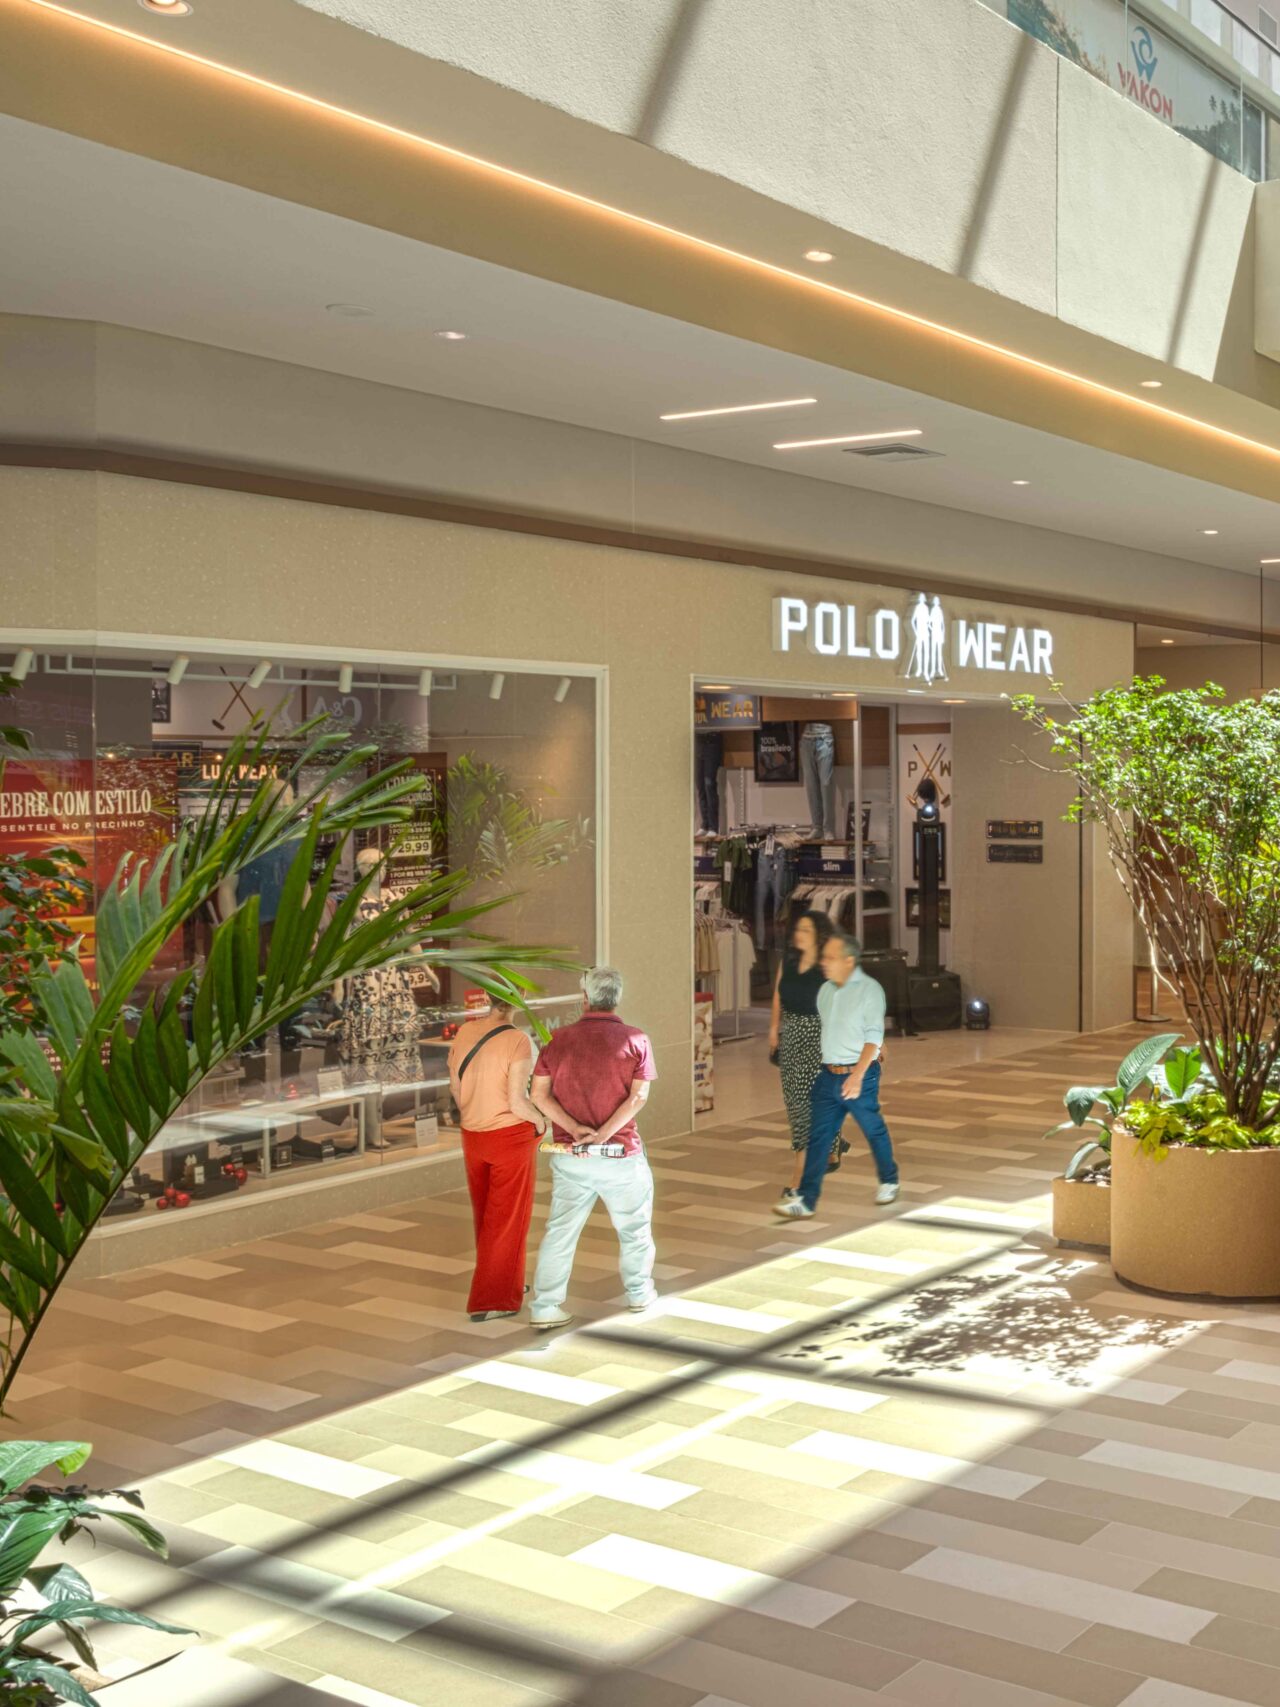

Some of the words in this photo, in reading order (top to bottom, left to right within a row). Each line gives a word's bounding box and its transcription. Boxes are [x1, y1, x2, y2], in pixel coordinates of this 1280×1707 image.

[779, 597, 900, 660] POLO
[958, 619, 1054, 675] WEAR
[711, 700, 753, 719] WEAR
[761, 742, 792, 753] brasileiro
[908, 760, 918, 777] P
[53, 790, 91, 816] COM
[95, 789, 151, 815] ESTILO
[62, 822, 79, 830] NO
[85, 820, 145, 830] PRECINHO
[823, 861, 841, 872] slim
